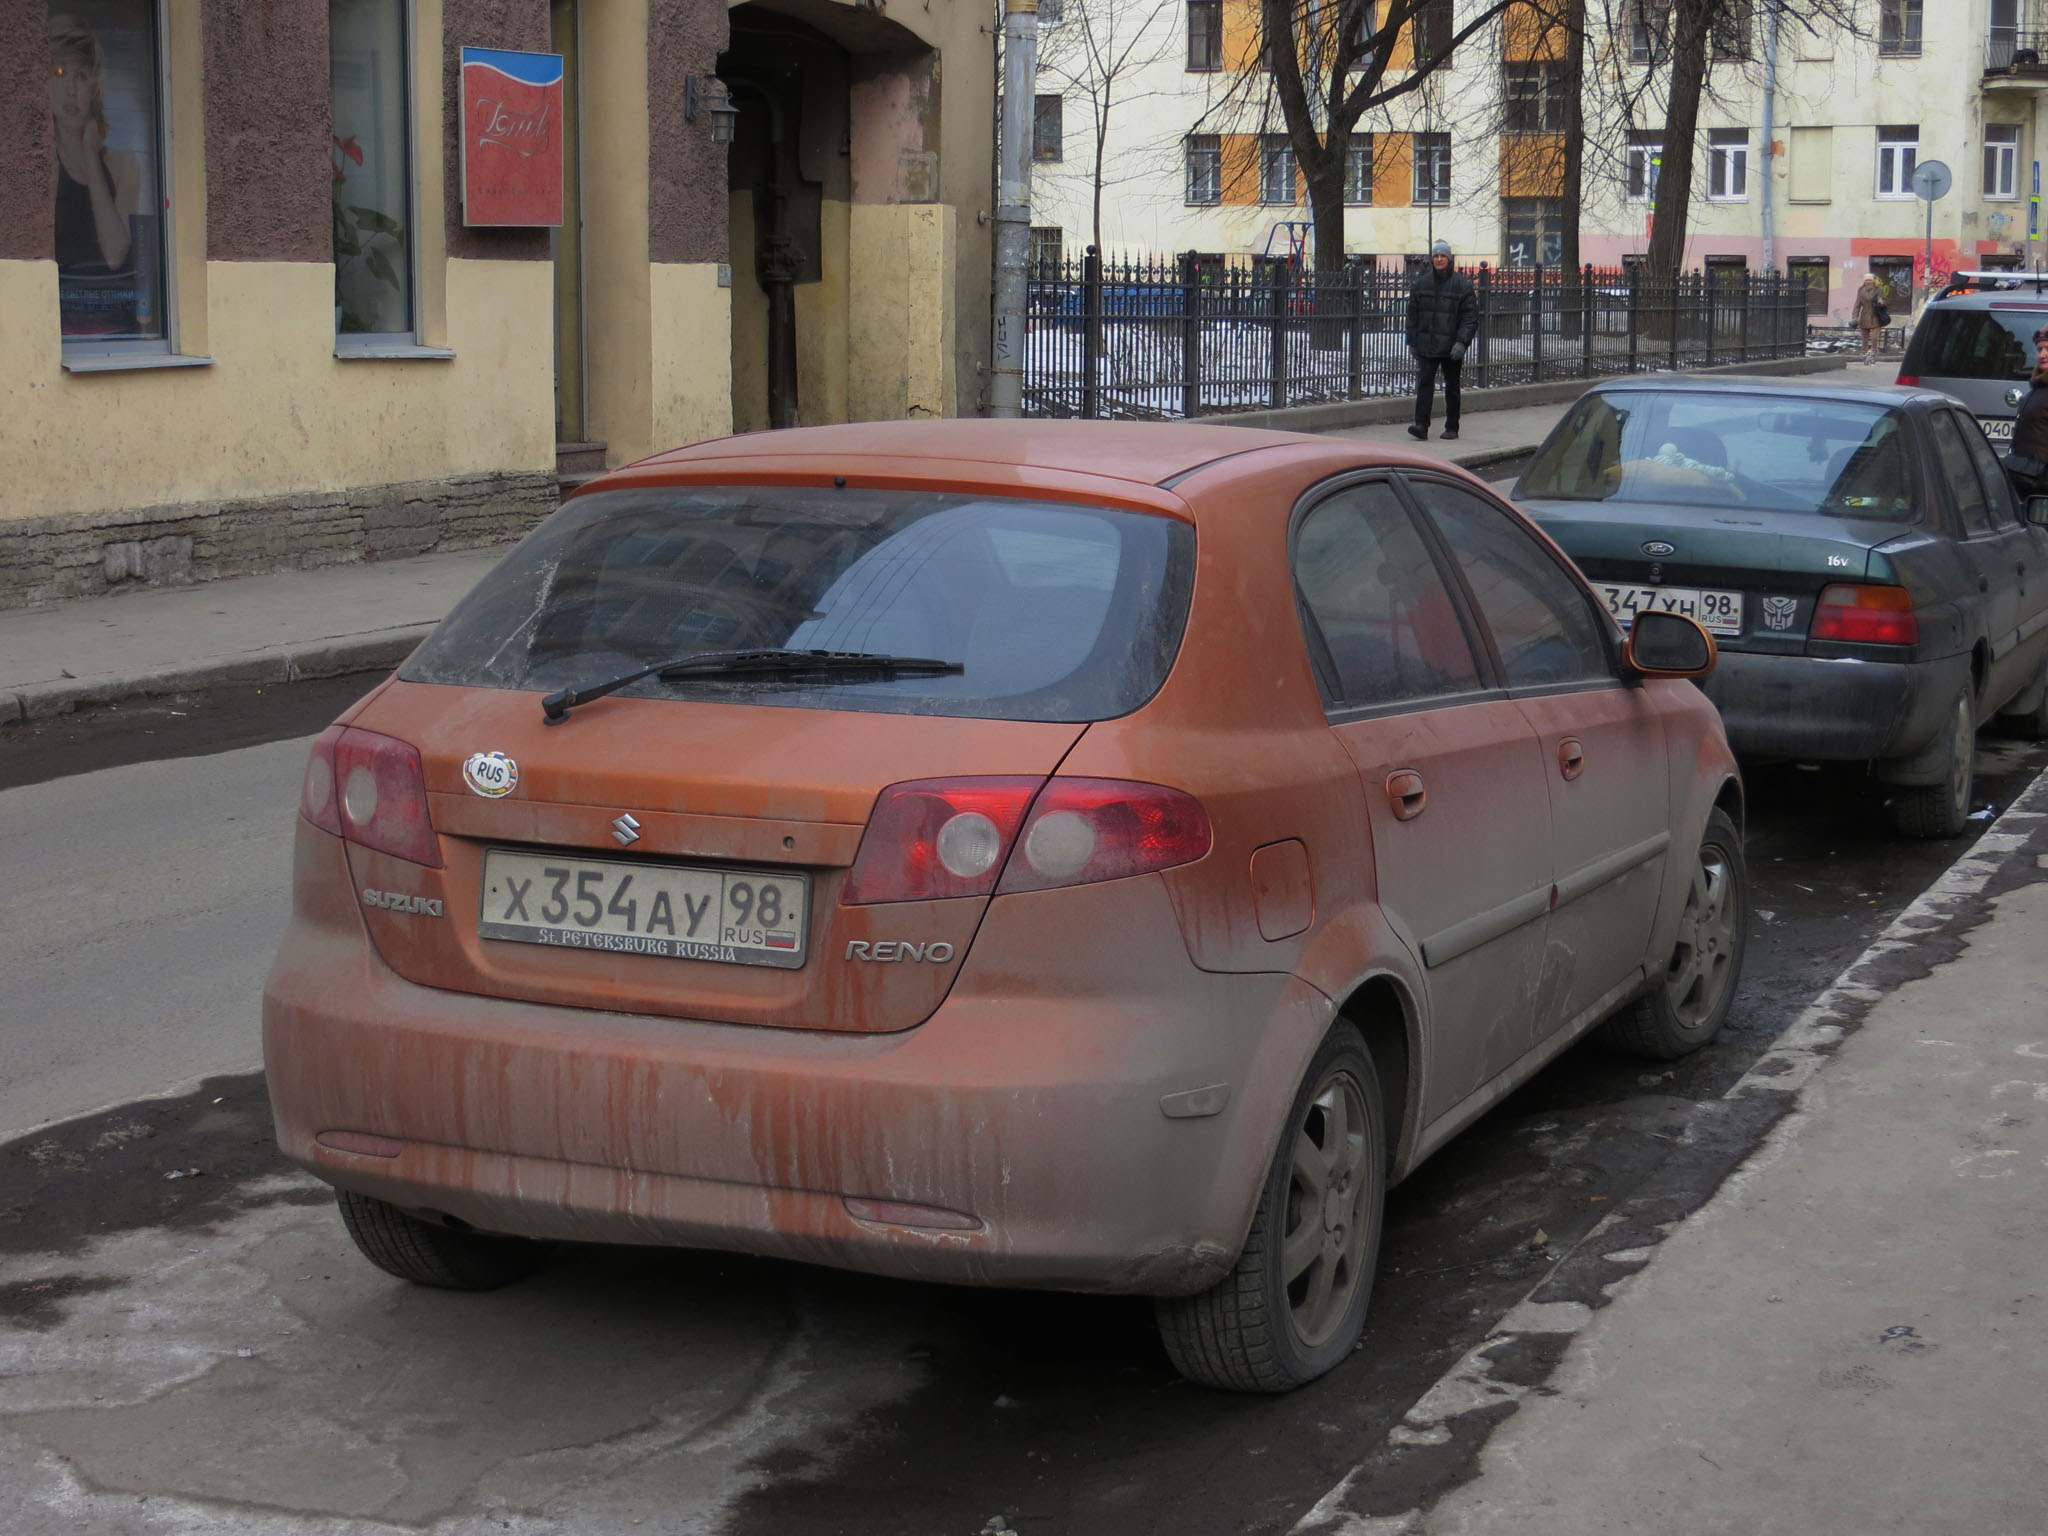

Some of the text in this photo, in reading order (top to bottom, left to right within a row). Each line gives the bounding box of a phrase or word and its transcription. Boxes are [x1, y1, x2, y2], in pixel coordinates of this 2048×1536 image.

[1983, 422, 2014, 437] 040
[1827, 555, 1849, 567] 16v
[1704, 594, 1731, 615] 98
[1701, 615, 1722, 623] RUS
[477, 761, 504, 784] RUS
[363, 888, 444, 917] SUZUKI
[728, 881, 782, 929] 98
[562, 930, 668, 955] PETERSBURG
[676, 942, 737, 961] RUSSIA
[724, 926, 763, 945] RUS
[844, 940, 955, 963] RENO
